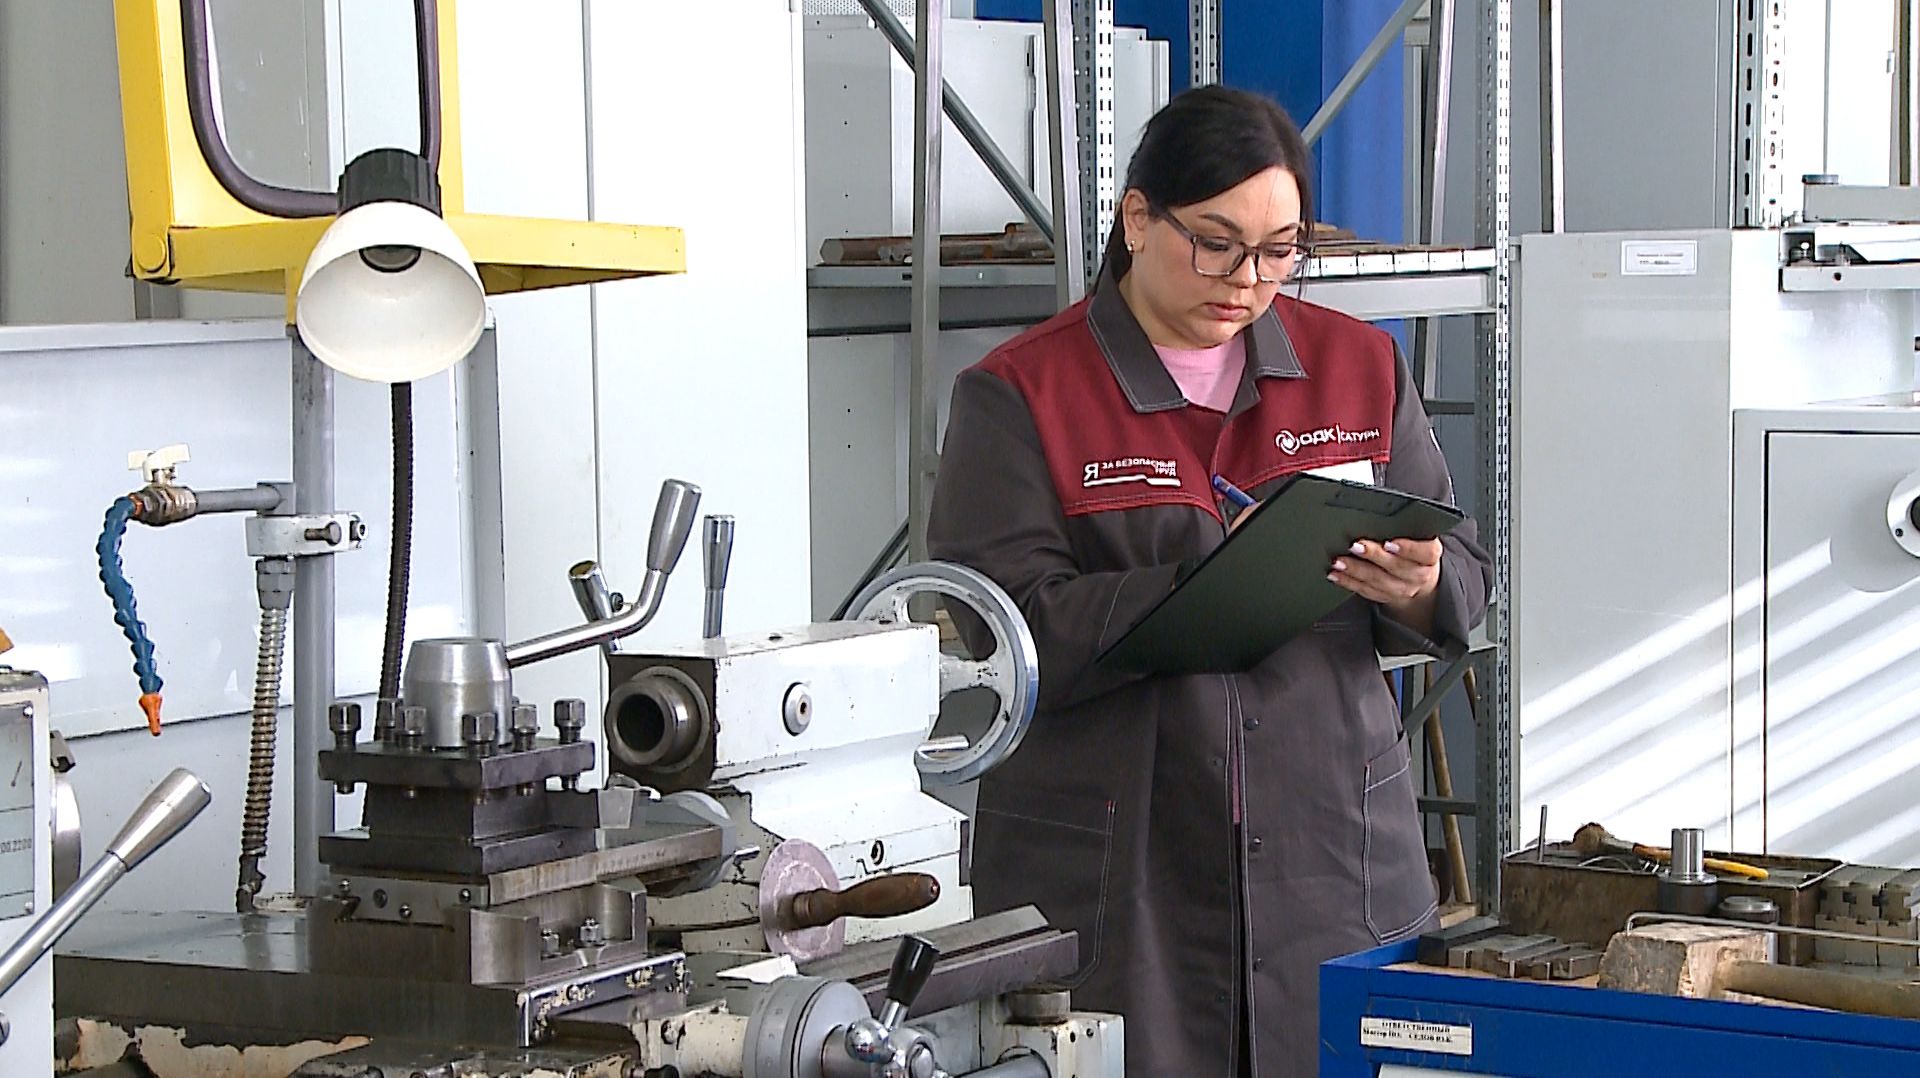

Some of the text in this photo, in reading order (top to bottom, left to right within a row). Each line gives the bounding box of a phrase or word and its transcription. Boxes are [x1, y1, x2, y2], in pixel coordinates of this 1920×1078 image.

[1300, 428, 1380, 445] ОДК САТУРН
[1083, 458, 1176, 481] Я ЗА БЕЗОПАСНЫЙ
